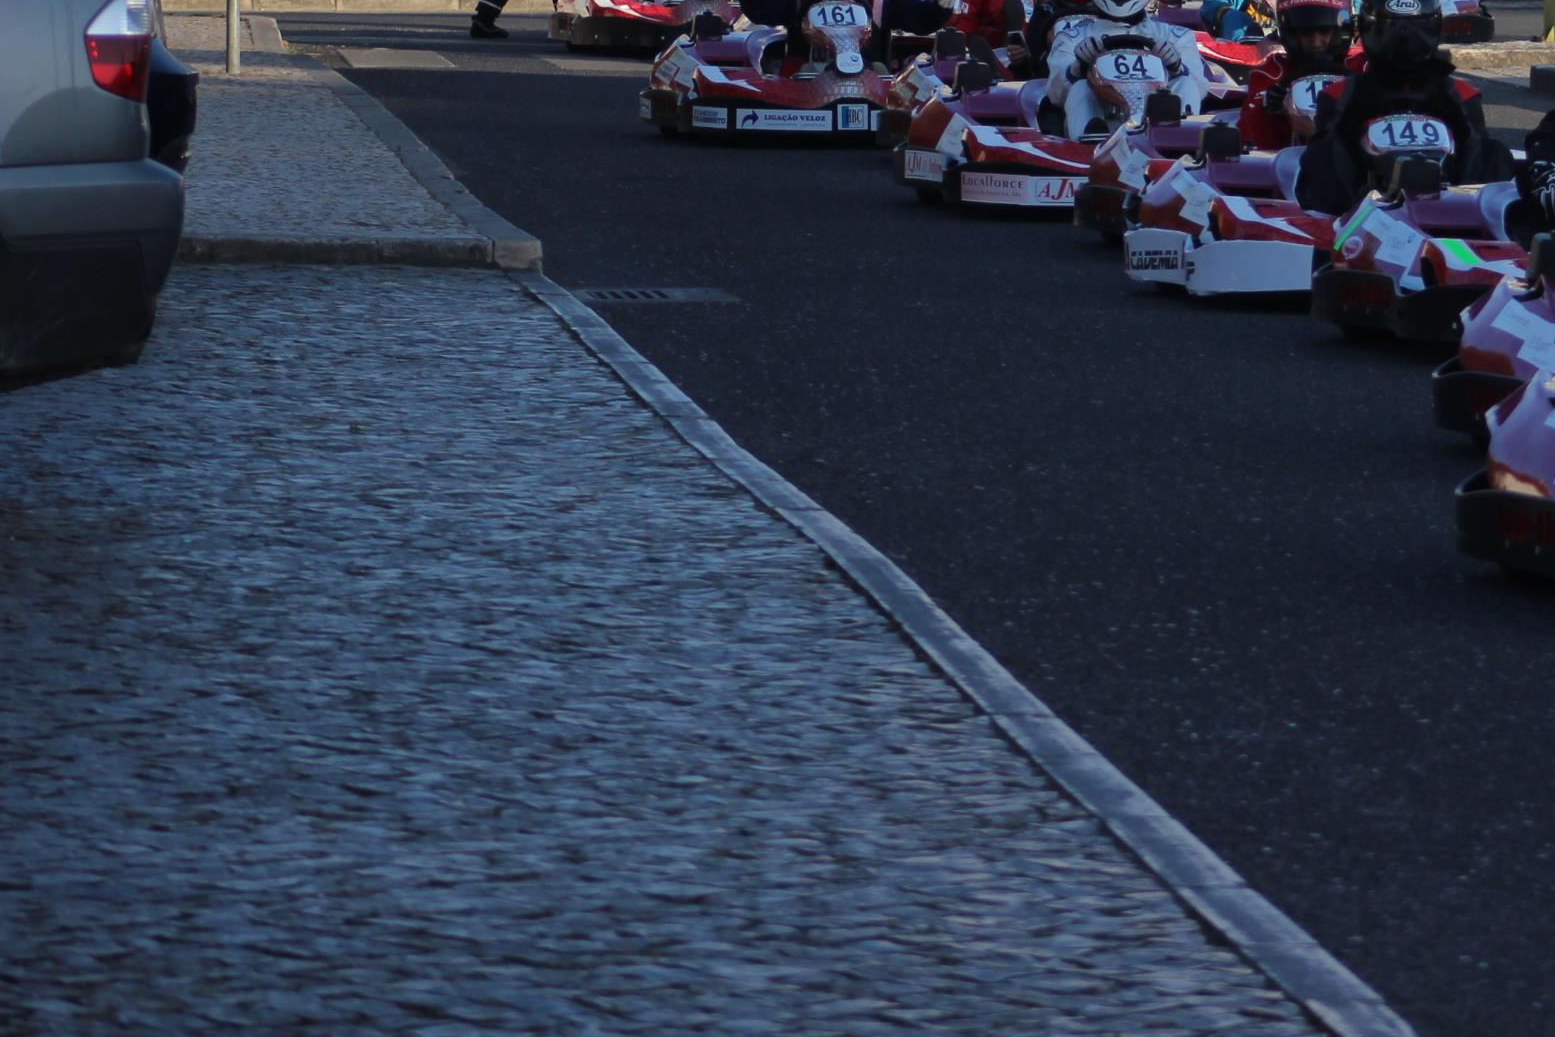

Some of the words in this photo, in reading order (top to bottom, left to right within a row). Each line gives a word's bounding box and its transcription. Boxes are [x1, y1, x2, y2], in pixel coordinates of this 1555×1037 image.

[817, 5, 857, 26] 161
[1114, 55, 1147, 77] 64
[764, 113, 799, 122] LIGAÇÃO
[1382, 121, 1439, 145] 149
